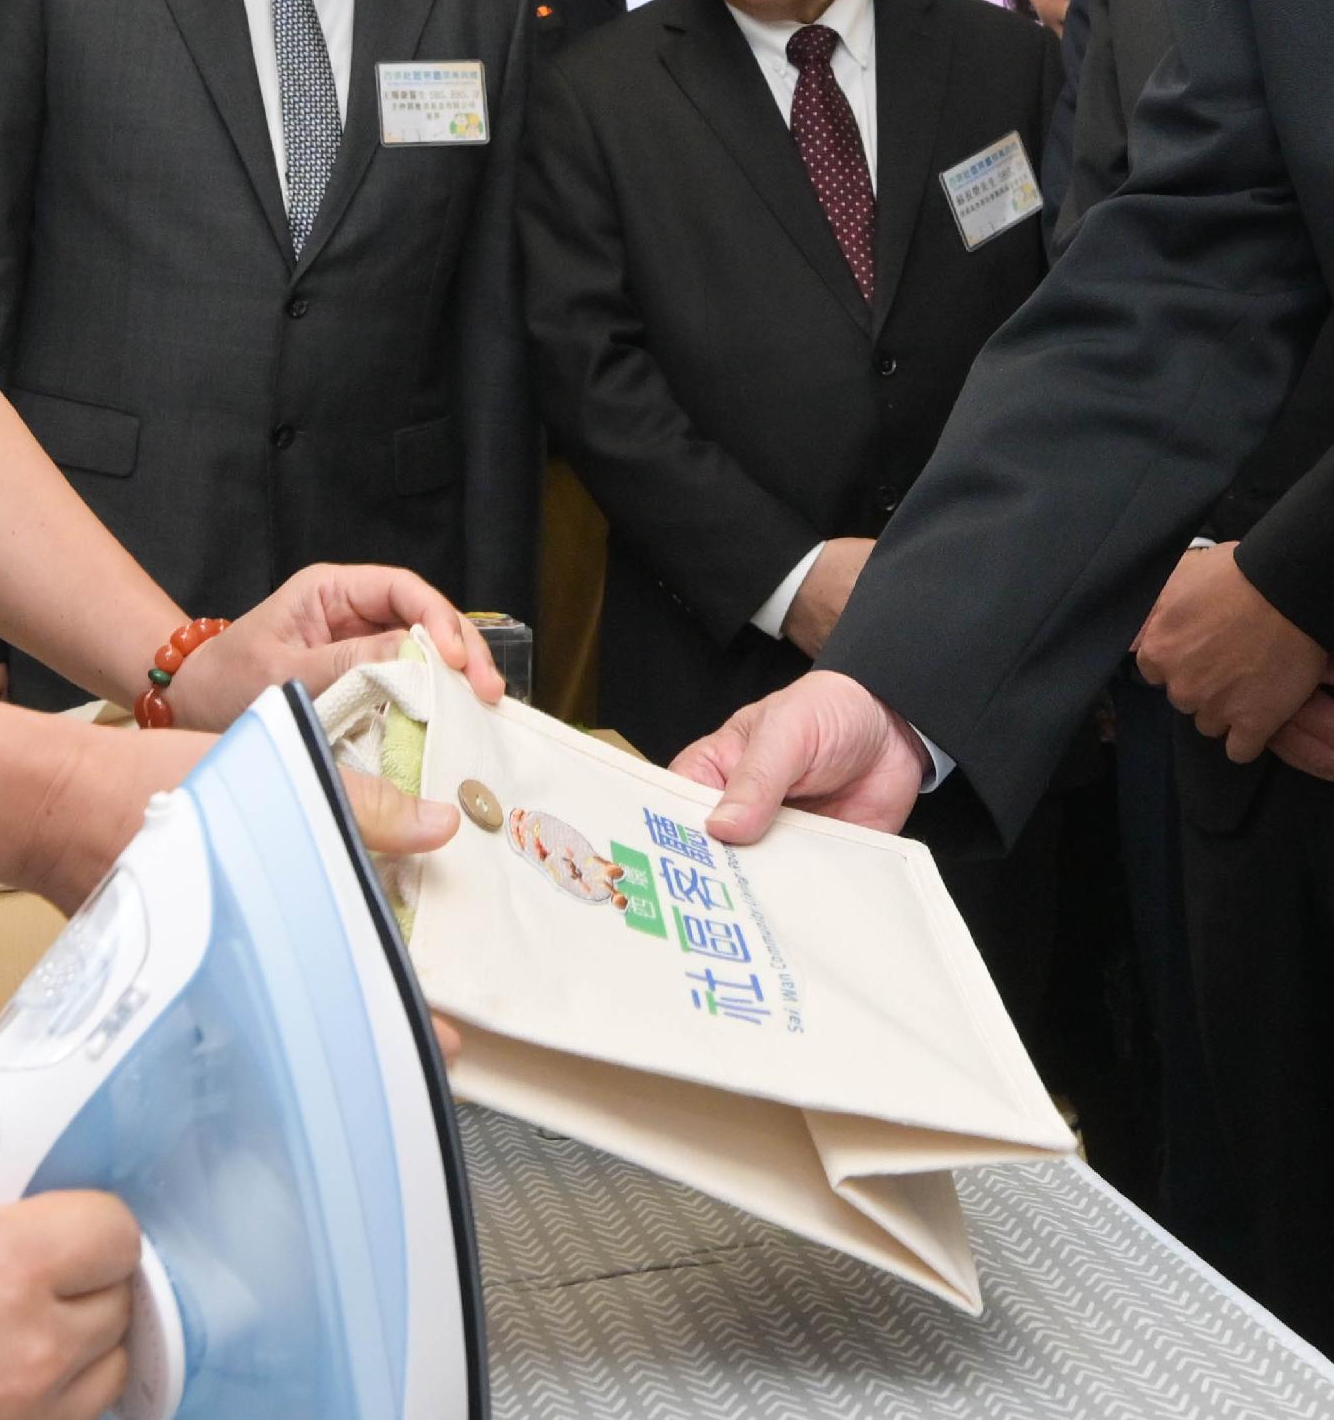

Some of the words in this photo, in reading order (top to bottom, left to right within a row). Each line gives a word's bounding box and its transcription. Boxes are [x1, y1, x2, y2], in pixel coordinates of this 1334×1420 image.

[642, 807, 772, 1026] 社區客廳
[778, 973, 799, 1002] Wan
[786, 1007, 804, 1034] Sai
